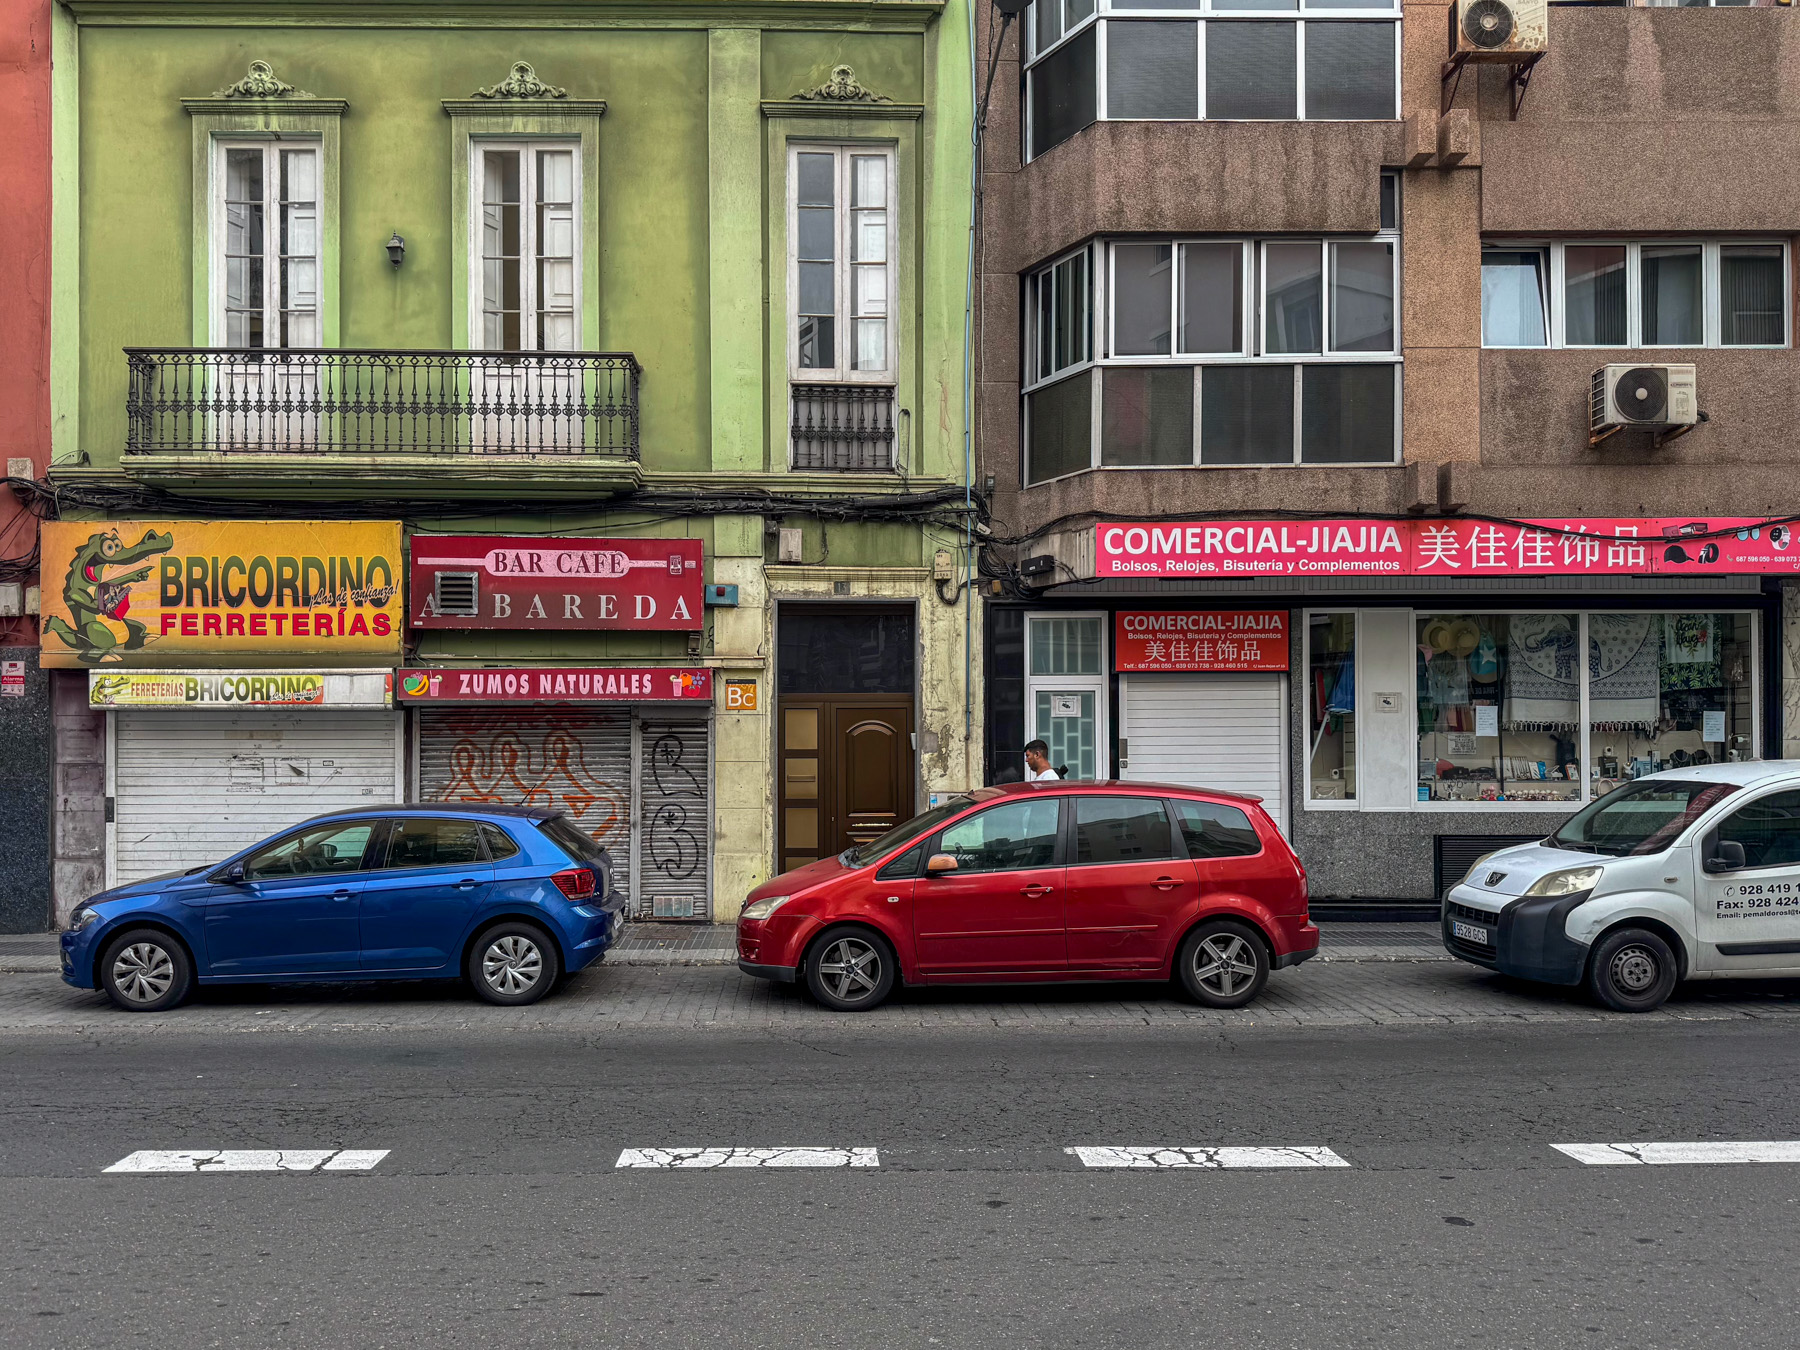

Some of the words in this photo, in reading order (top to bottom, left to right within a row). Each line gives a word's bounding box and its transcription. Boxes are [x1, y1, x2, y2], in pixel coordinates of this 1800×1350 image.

[1103, 526, 1402, 554] COMERCIAL-JIAJIA
[1417, 524, 1646, 569] 美佳佳饰品
[493, 552, 544, 573] BAR
[1111, 559, 1162, 573] Bolsos,
[1166, 559, 1220, 574] Relojes,
[1223, 559, 1284, 572] Bisutería
[1286, 561, 1295, 573] y
[1298, 558, 1400, 573] Complementos
[159, 555, 393, 608] BRICORDINO
[335, 586, 347, 603] de
[350, 578, 399, 603] confianza!
[419, 592, 693, 620] ABAREDA
[160, 608, 392, 636] FERRETERÍAS
[1123, 615, 1282, 631] COMERCIAL-JIAJIA
[1127, 632, 1155, 640] Bolsos,
[1156, 632, 1185, 640] Relojes,
[1227, 632, 1281, 640] Complementos
[1144, 640, 1261, 662] 美佳佳饰品
[130, 679, 184, 698] FERRETERÍAS
[185, 676, 317, 702] BRICORDINO
[459, 673, 530, 695] ZUMOS
[539, 673, 653, 695] NATURALES
[728, 687, 754, 707] Bc
[1739, 885, 1763, 895] 928
[1767, 883, 1791, 894] 419
[1716, 900, 1744, 909] Fax:
[1747, 897, 1771, 908] 928
[1775, 896, 1799, 907] 424
[1456, 924, 1471, 939] 9528
